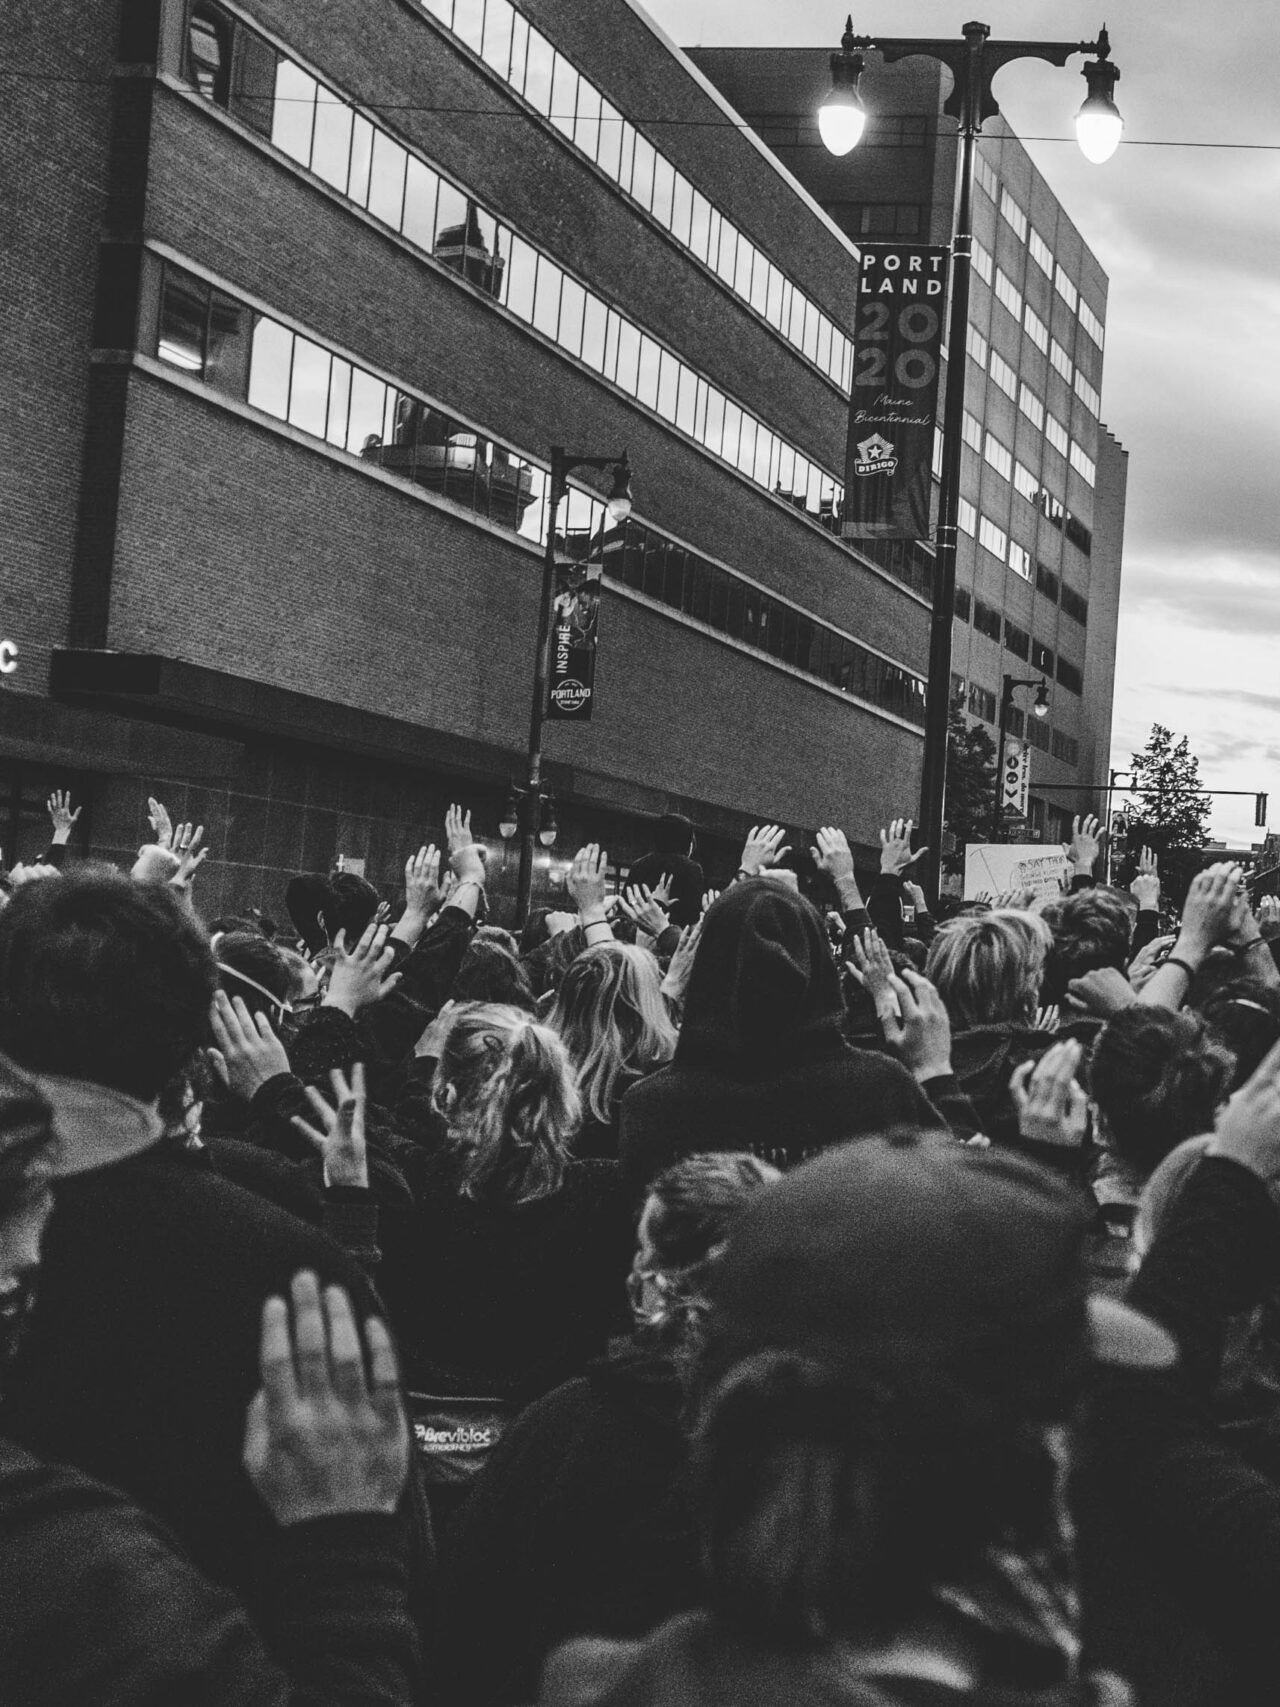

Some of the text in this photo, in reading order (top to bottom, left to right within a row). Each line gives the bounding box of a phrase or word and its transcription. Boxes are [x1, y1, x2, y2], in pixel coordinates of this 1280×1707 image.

[862, 254, 943, 272] PORT
[860, 277, 943, 296] LAND
[858, 301, 939, 343] 20
[855, 347, 936, 389] 20
[873, 393, 913, 406] Maine
[854, 409, 931, 426] Bicentennial
[858, 460, 894, 473] DIRIGO
[555, 625, 571, 674] INSPIRE
[551, 688, 591, 700] PORTLAND
[425, 1427, 490, 1442] Brevibloc
